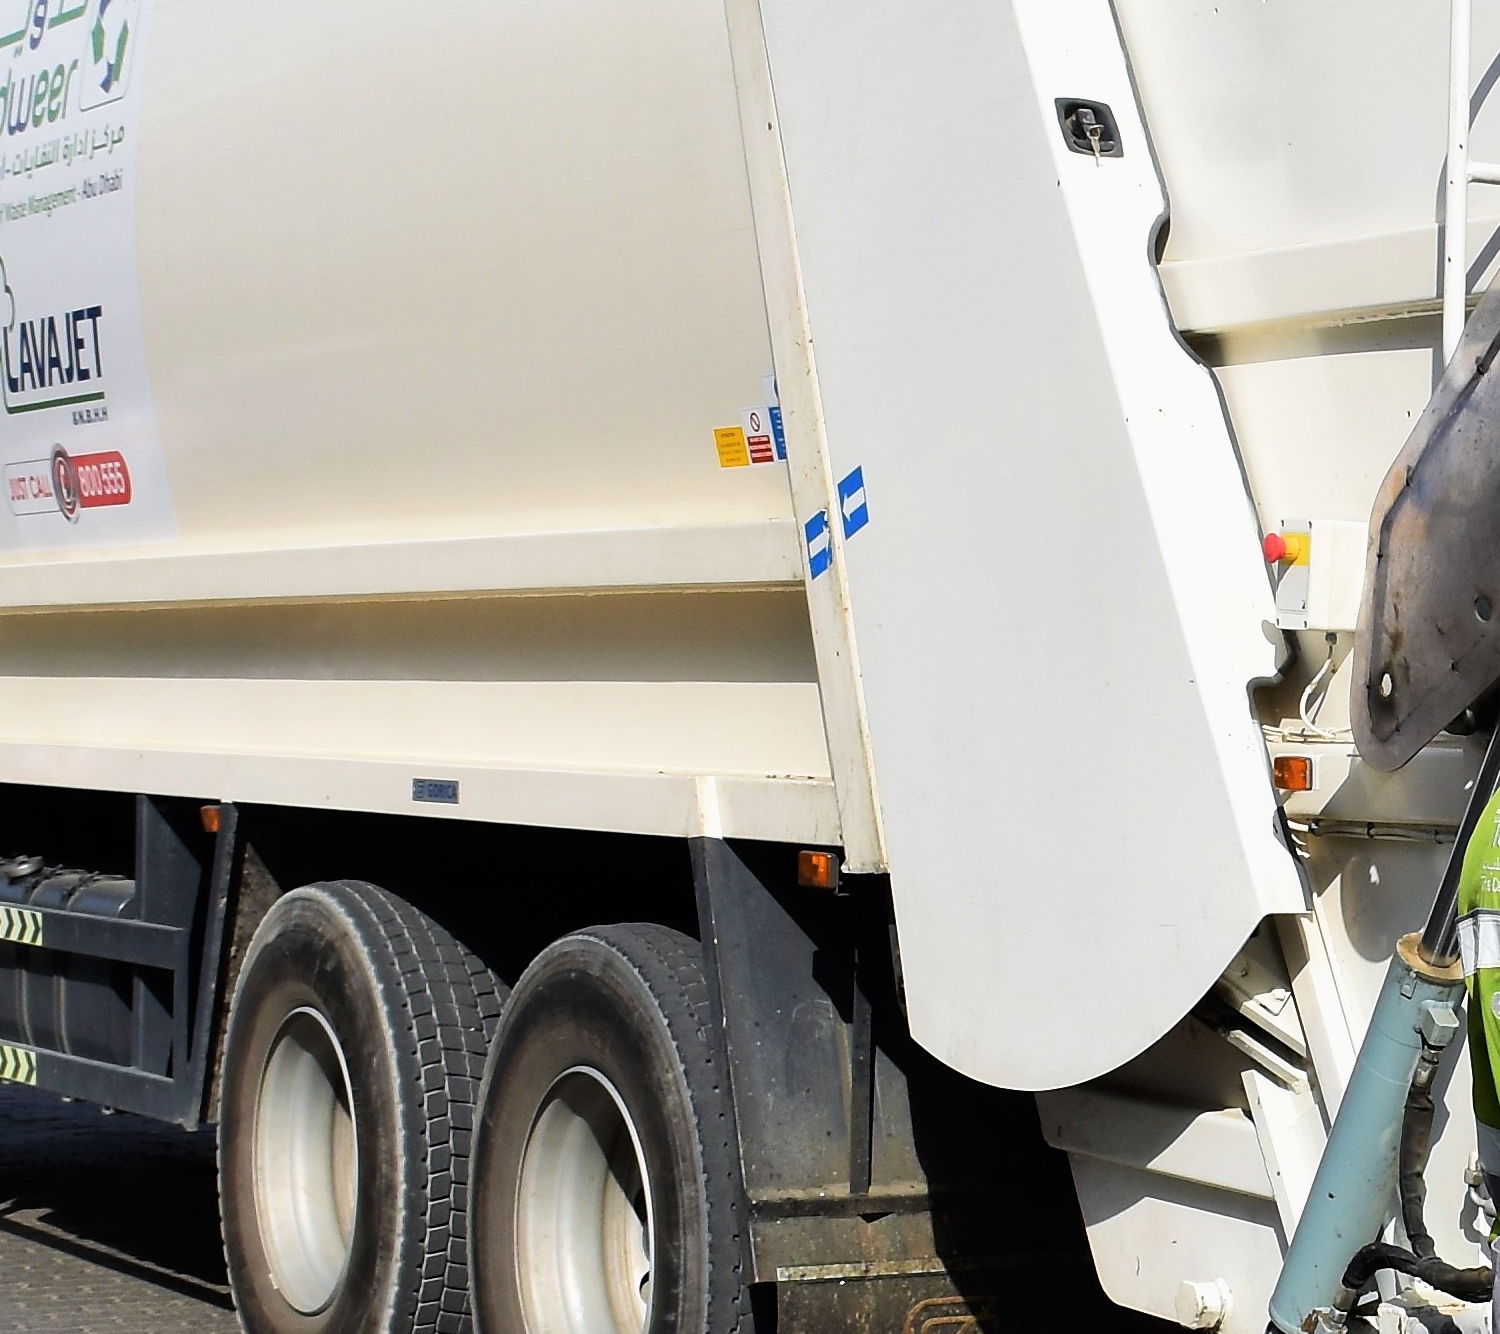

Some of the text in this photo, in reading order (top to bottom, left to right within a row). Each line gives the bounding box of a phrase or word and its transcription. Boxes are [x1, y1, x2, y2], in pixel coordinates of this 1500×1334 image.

[82, 177, 100, 200] Abu
[100, 167, 123, 196] Dhabi
[3, 305, 103, 394] LAVAJET
